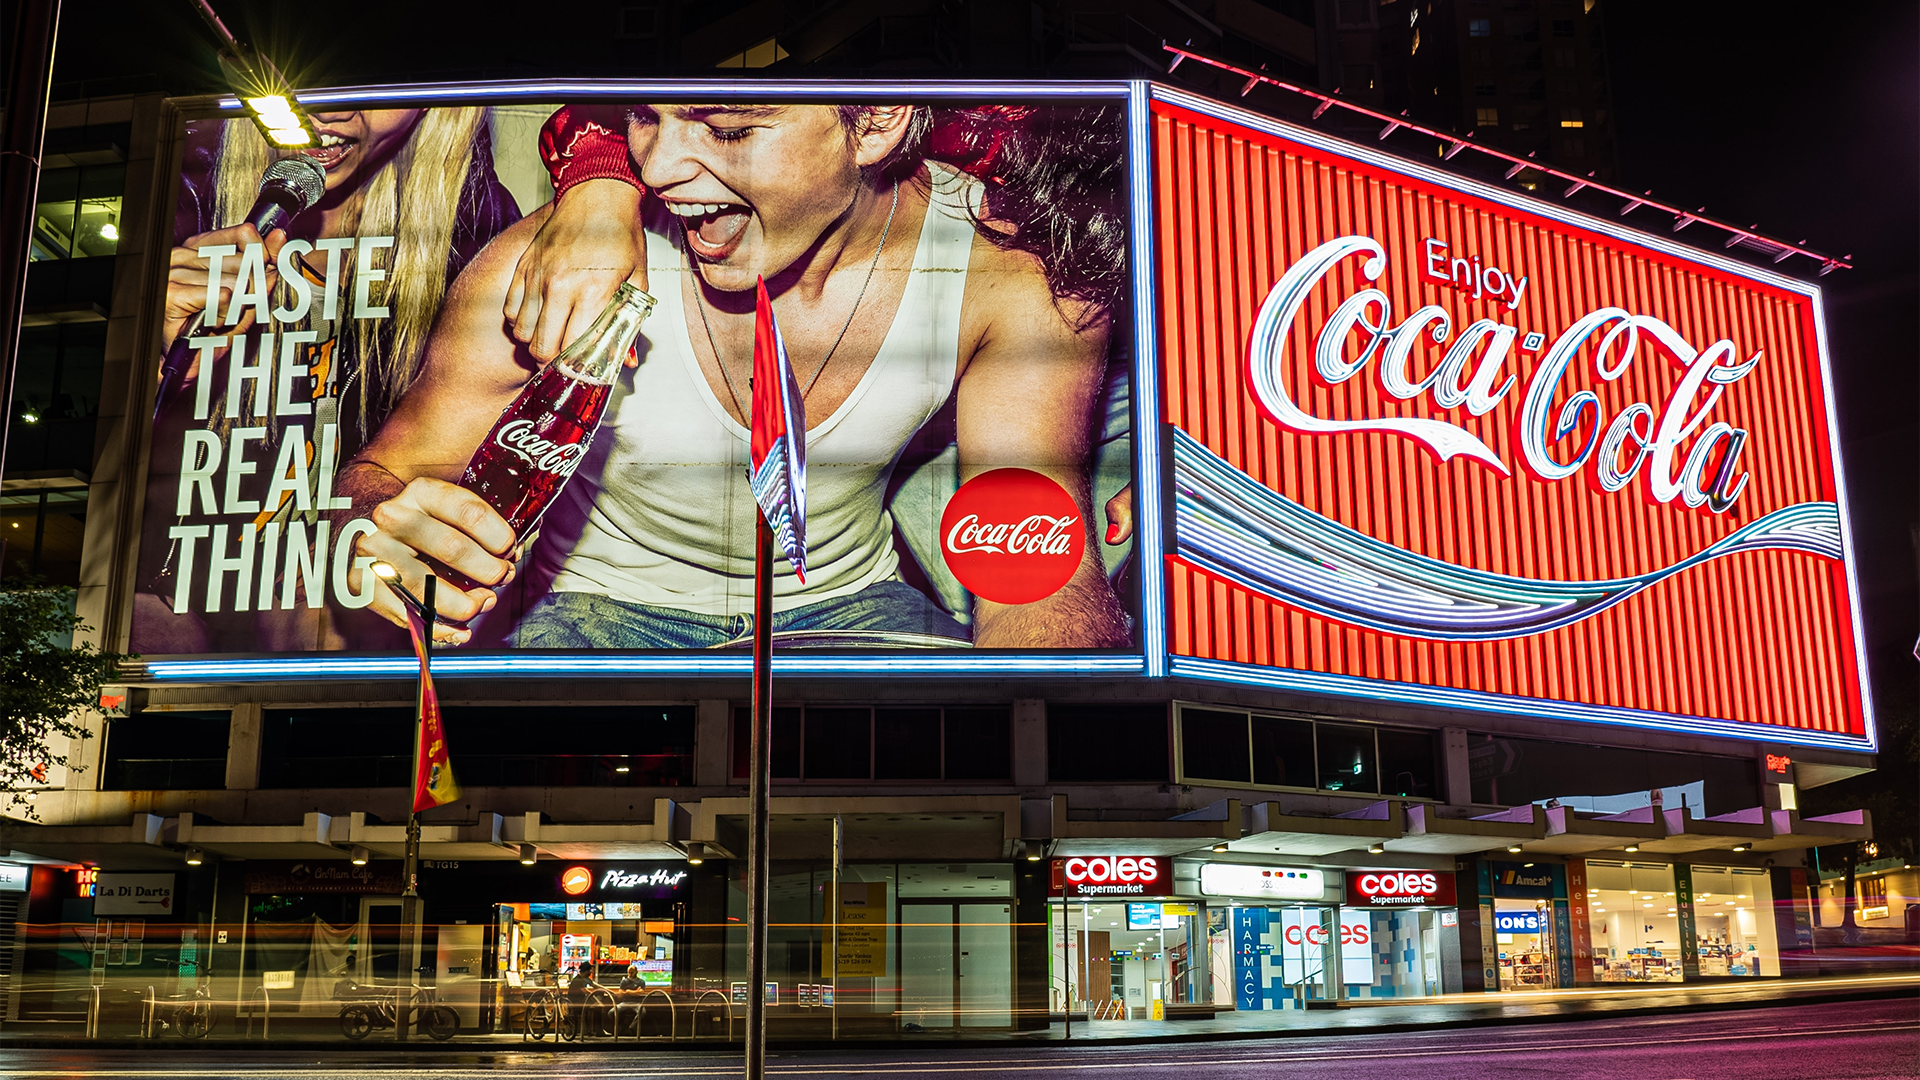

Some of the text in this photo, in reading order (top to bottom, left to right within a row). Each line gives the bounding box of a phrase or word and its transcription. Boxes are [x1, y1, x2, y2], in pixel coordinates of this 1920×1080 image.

[197, 236, 395, 327] TASTE
[1424, 237, 1528, 309] Enjoy
[188, 331, 319, 420] THE
[1247, 235, 1763, 515] Coca-Cola
[177, 424, 352, 516] REAL
[947, 514, 1079, 555] Coca-Cola
[169, 518, 378, 614] THING
[436, 861, 459, 869] TG15
[1065, 856, 1158, 882] coles
[100, 886, 170, 897] La Di Darts
[600, 869, 687, 890] Pizza Hut
[1077, 883, 1144, 895] Supermarket
[1360, 872, 1438, 895] coles
[1370, 894, 1425, 905] Supermarket
[842, 911, 867, 919] Lease
[1285, 924, 1369, 946] coes
[1557, 909, 1569, 986] PHARMACY
